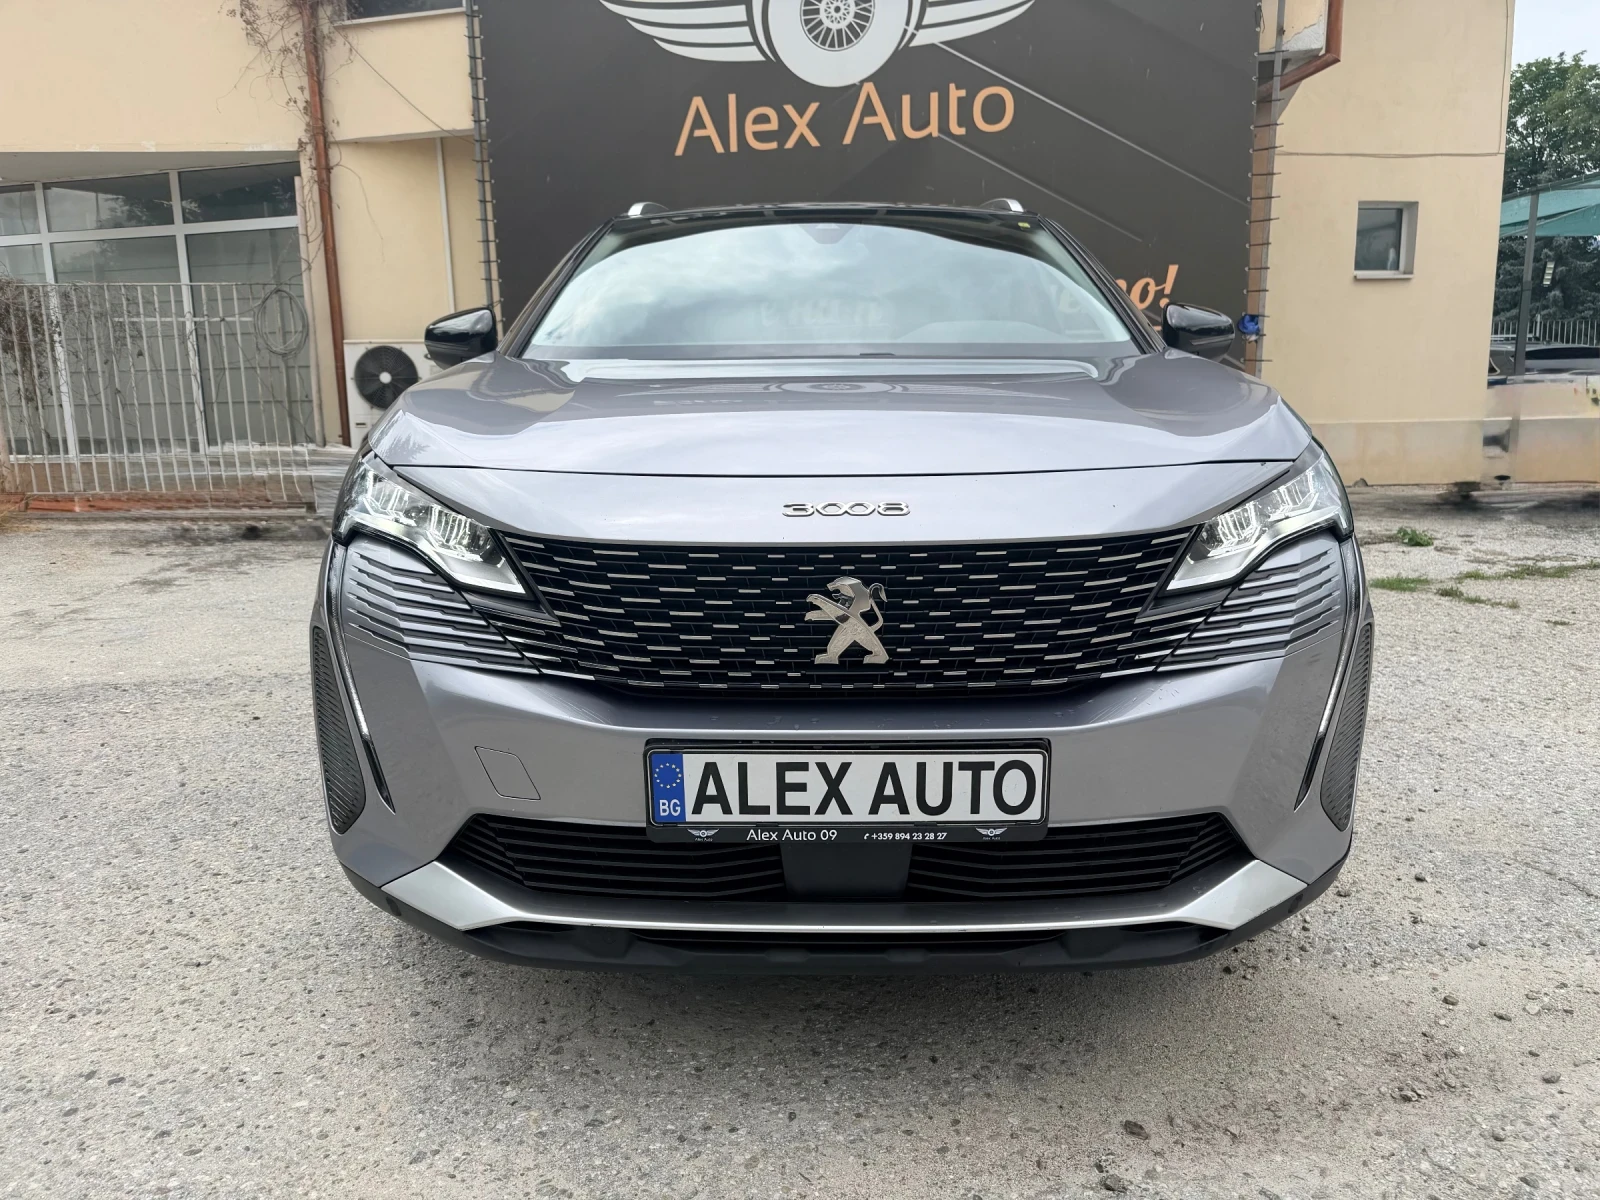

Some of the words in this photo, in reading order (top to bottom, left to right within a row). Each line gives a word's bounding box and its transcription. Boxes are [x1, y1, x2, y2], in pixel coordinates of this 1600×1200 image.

[675, 93, 821, 157] Alex
[842, 81, 1015, 145] Auto
[782, 501, 911, 518] 3008
[691, 761, 854, 816] ALEX
[868, 759, 1037, 816] AUTO
[659, 799, 681, 817] BG
[746, 829, 778, 841] Alex
[782, 829, 817, 841] Auto
[820, 829, 838, 841] 09
[871, 832, 893, 841] +359
[895, 832, 910, 841] 894
[912, 832, 923, 841] 23
[925, 832, 935, 841] 28
[936, 832, 948, 841] 27
